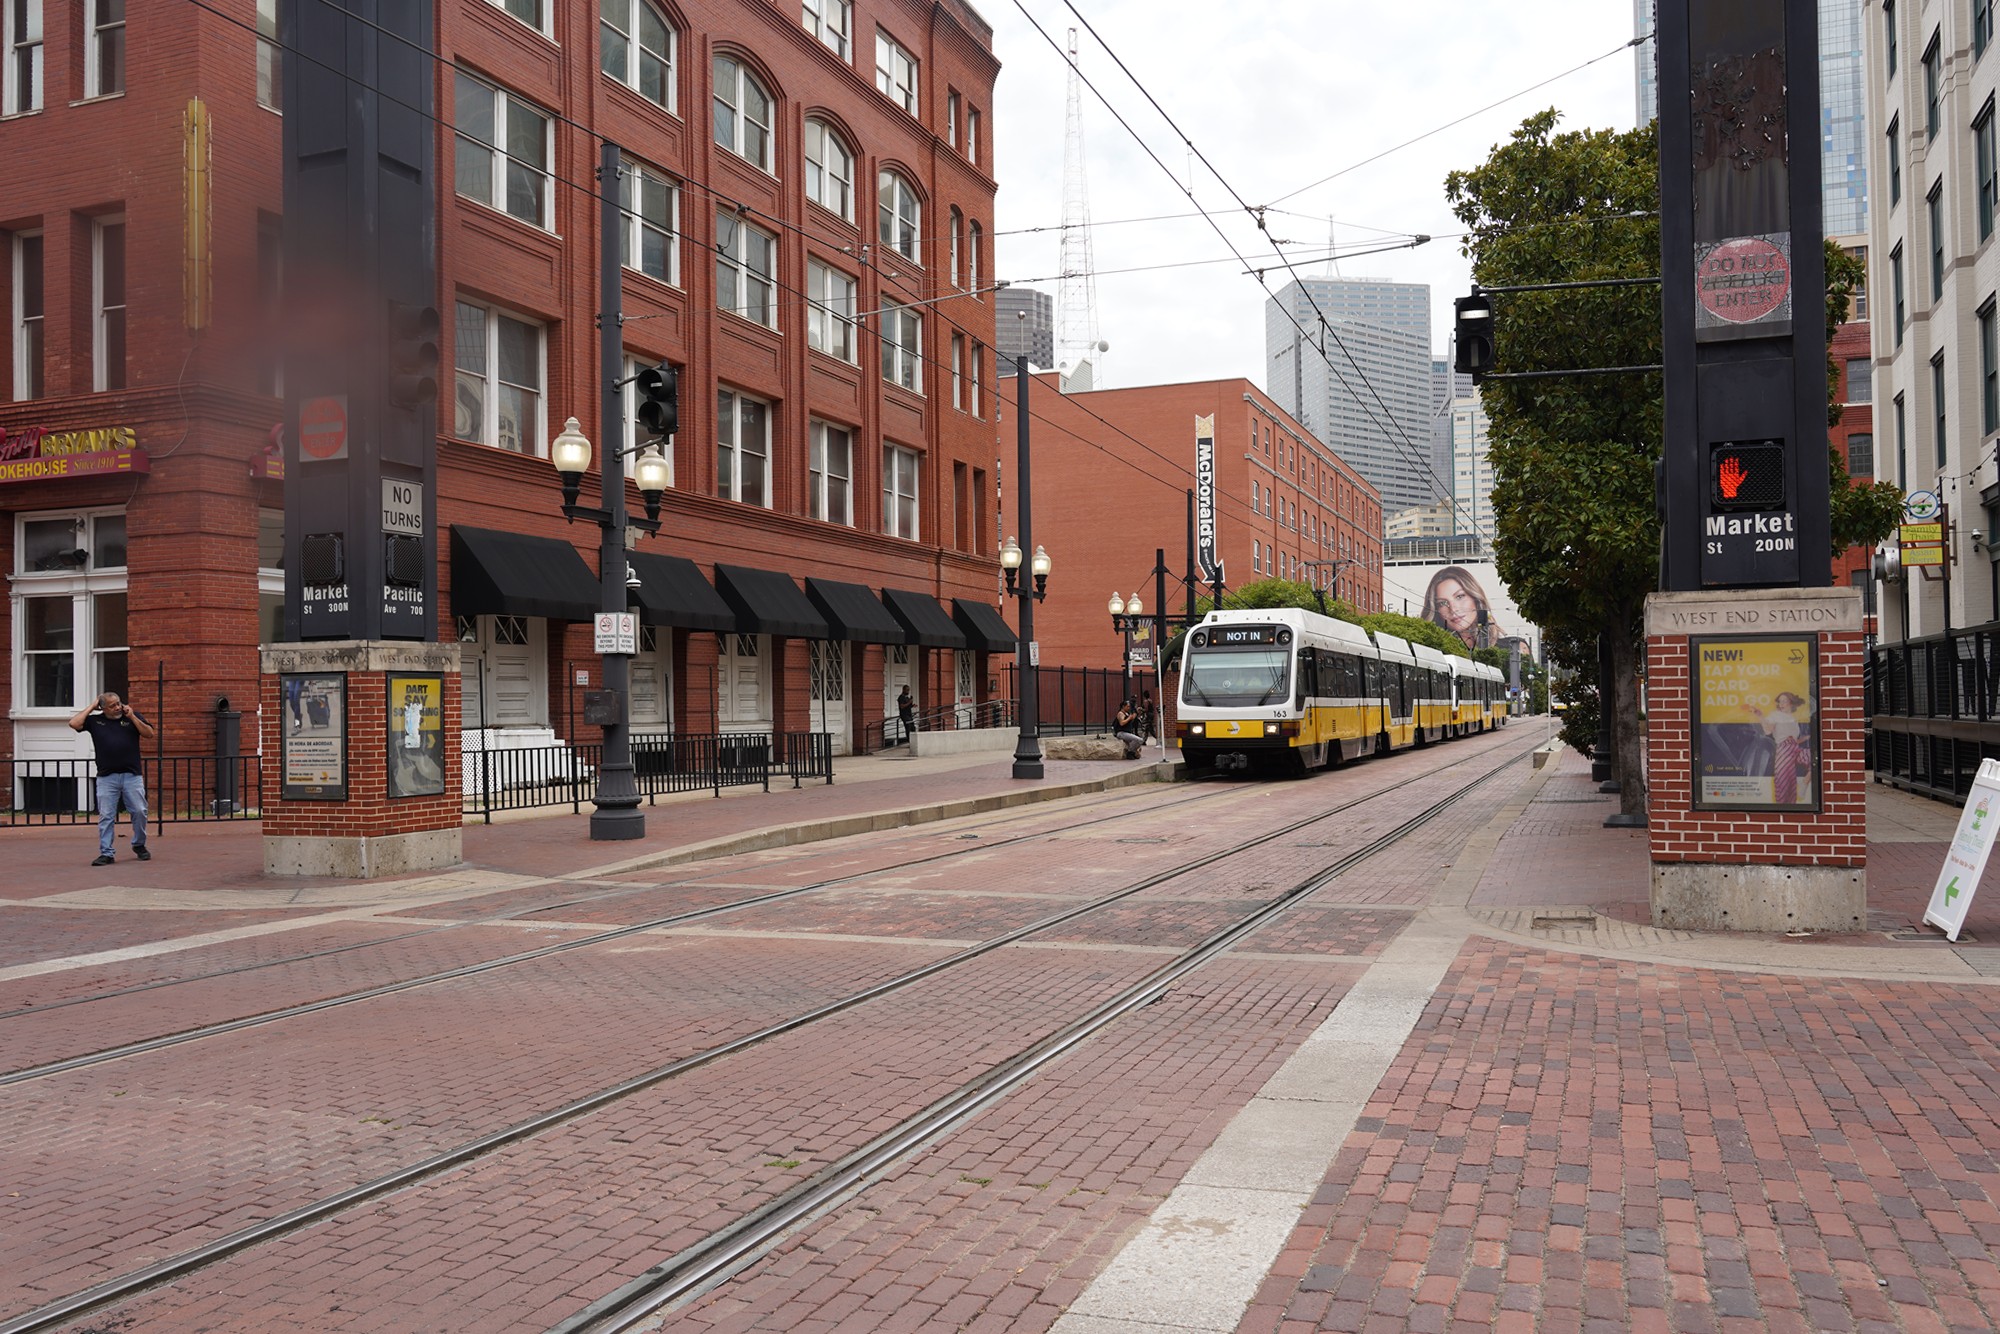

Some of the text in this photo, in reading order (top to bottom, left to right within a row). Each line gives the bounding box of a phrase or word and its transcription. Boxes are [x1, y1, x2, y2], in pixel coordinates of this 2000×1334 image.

[1709, 252, 1777, 272] DO NOT
[1716, 289, 1771, 307] ENTER
[40, 427, 136, 457] BRYAN'S
[73, 460, 95, 471] Since
[97, 457, 115, 470] 1910
[393, 486, 412, 504] NO
[1199, 444, 1213, 548] McDonald's
[384, 510, 421, 528] TURNS
[1706, 513, 1793, 536] Market
[1905, 525, 1938, 534] Family
[1707, 538, 1794, 554] St 200N
[303, 584, 348, 601] Market
[384, 586, 423, 602] Pacific
[304, 602, 349, 614] St 300N
[384, 604, 423, 615] Ave 700
[1672, 608, 1837, 627] WEST END STATION
[1227, 632, 1260, 640] NOT IN
[272, 655, 357, 666] WEST END STATION
[379, 654, 452, 665] WEST END STATION
[1703, 650, 1743, 661] NEW!
[1704, 664, 1781, 676] TAP YOUR
[406, 684, 428, 694] DART
[1704, 680, 1750, 691] CARD
[404, 695, 428, 706] SAY
[1705, 694, 1770, 706] AND GO
[394, 707, 438, 717] SOHING
